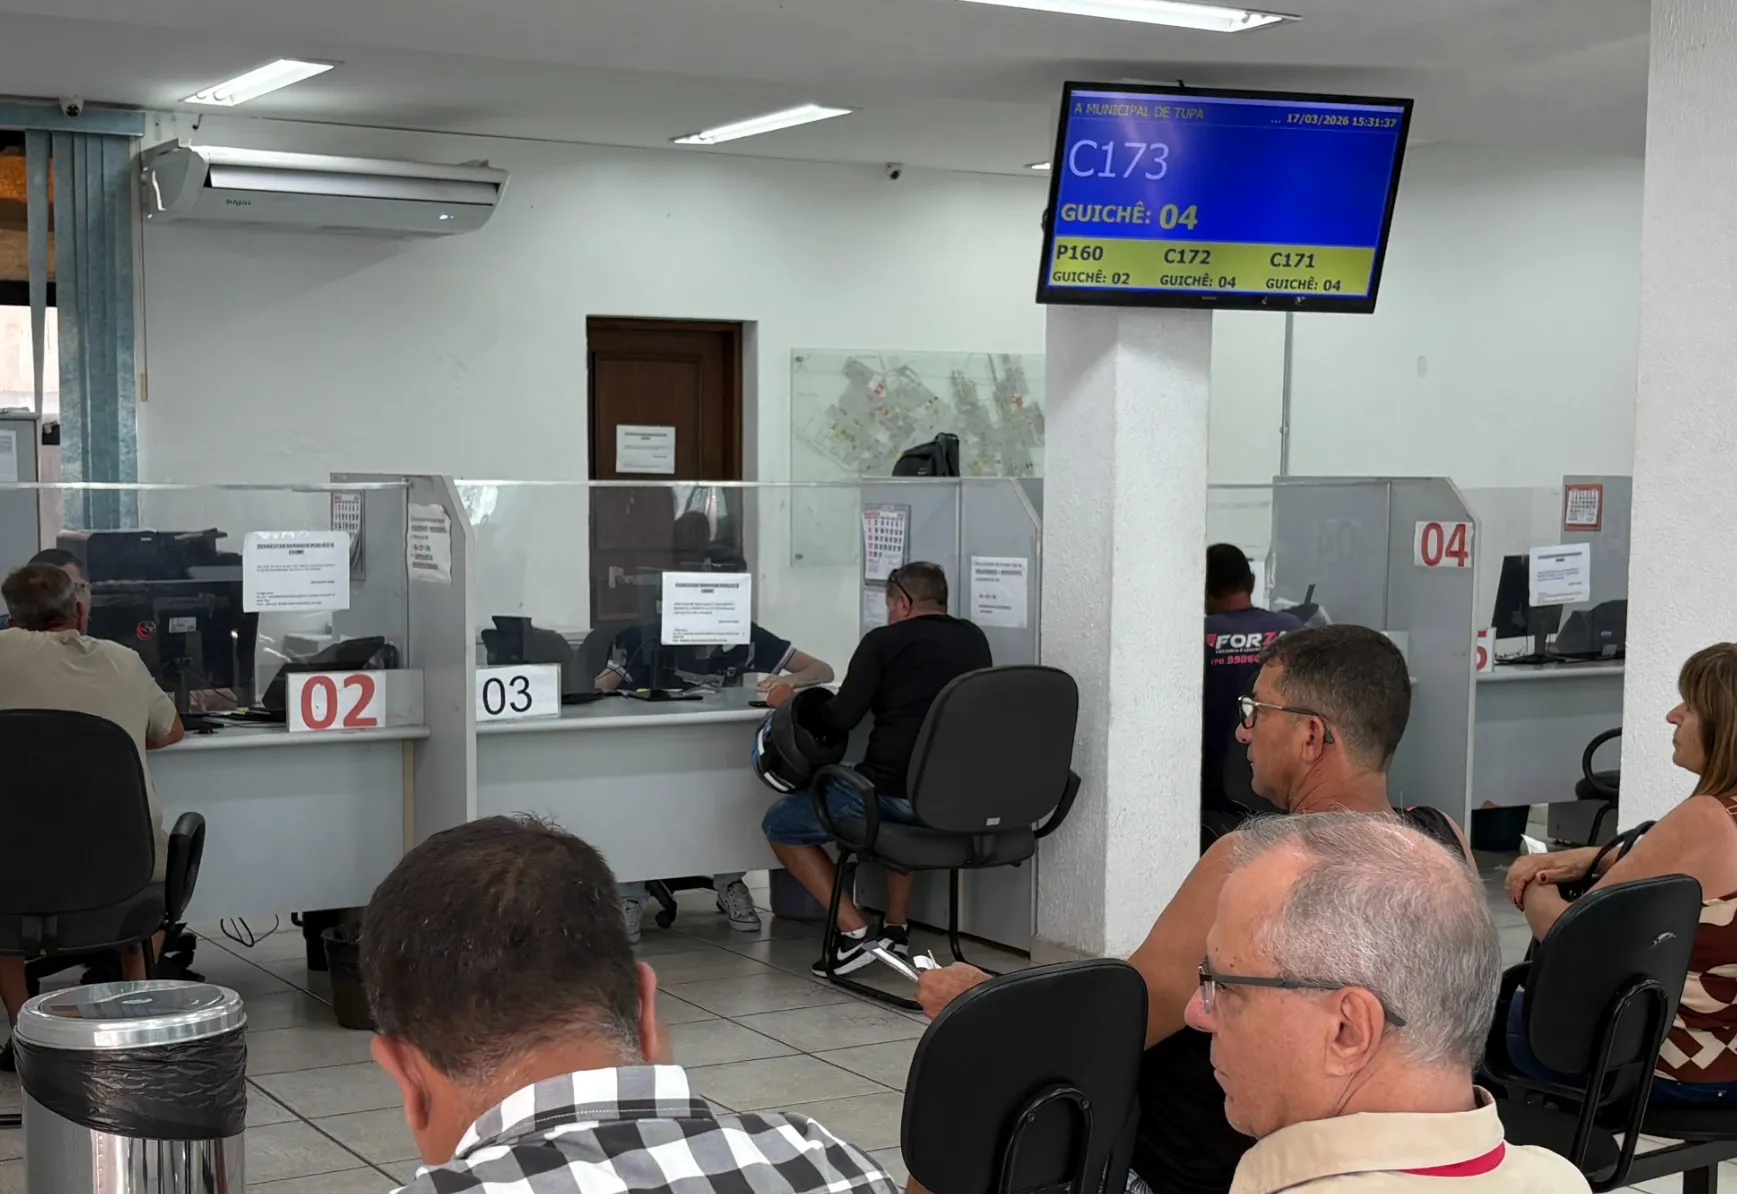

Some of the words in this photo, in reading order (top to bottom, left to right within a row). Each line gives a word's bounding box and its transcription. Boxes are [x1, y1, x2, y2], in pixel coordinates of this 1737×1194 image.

[1086, 103, 1149, 117] MUNICIPAL
[1154, 106, 1171, 118] DE
[1287, 113, 1349, 126] 17/03/2026
[1352, 116, 1397, 128] 15:31:37
[1068, 139, 1169, 181] C173
[1060, 201, 1151, 225] GUICHÊ:
[1159, 203, 1198, 231] 04
[1056, 244, 1104, 261] P160
[1163, 248, 1212, 265] C172
[1269, 252, 1316, 269] C171
[1052, 269, 1107, 284] GUICHÊ:
[1111, 272, 1131, 285] 02
[1160, 273, 1213, 288] GUICHÊ:
[1218, 276, 1237, 289] 04
[1265, 276, 1318, 291] GUICHÊ:
[1323, 279, 1341, 292] 04
[1421, 522, 1469, 567] 04
[300, 673, 378, 731] 02
[482, 675, 533, 716] 03
